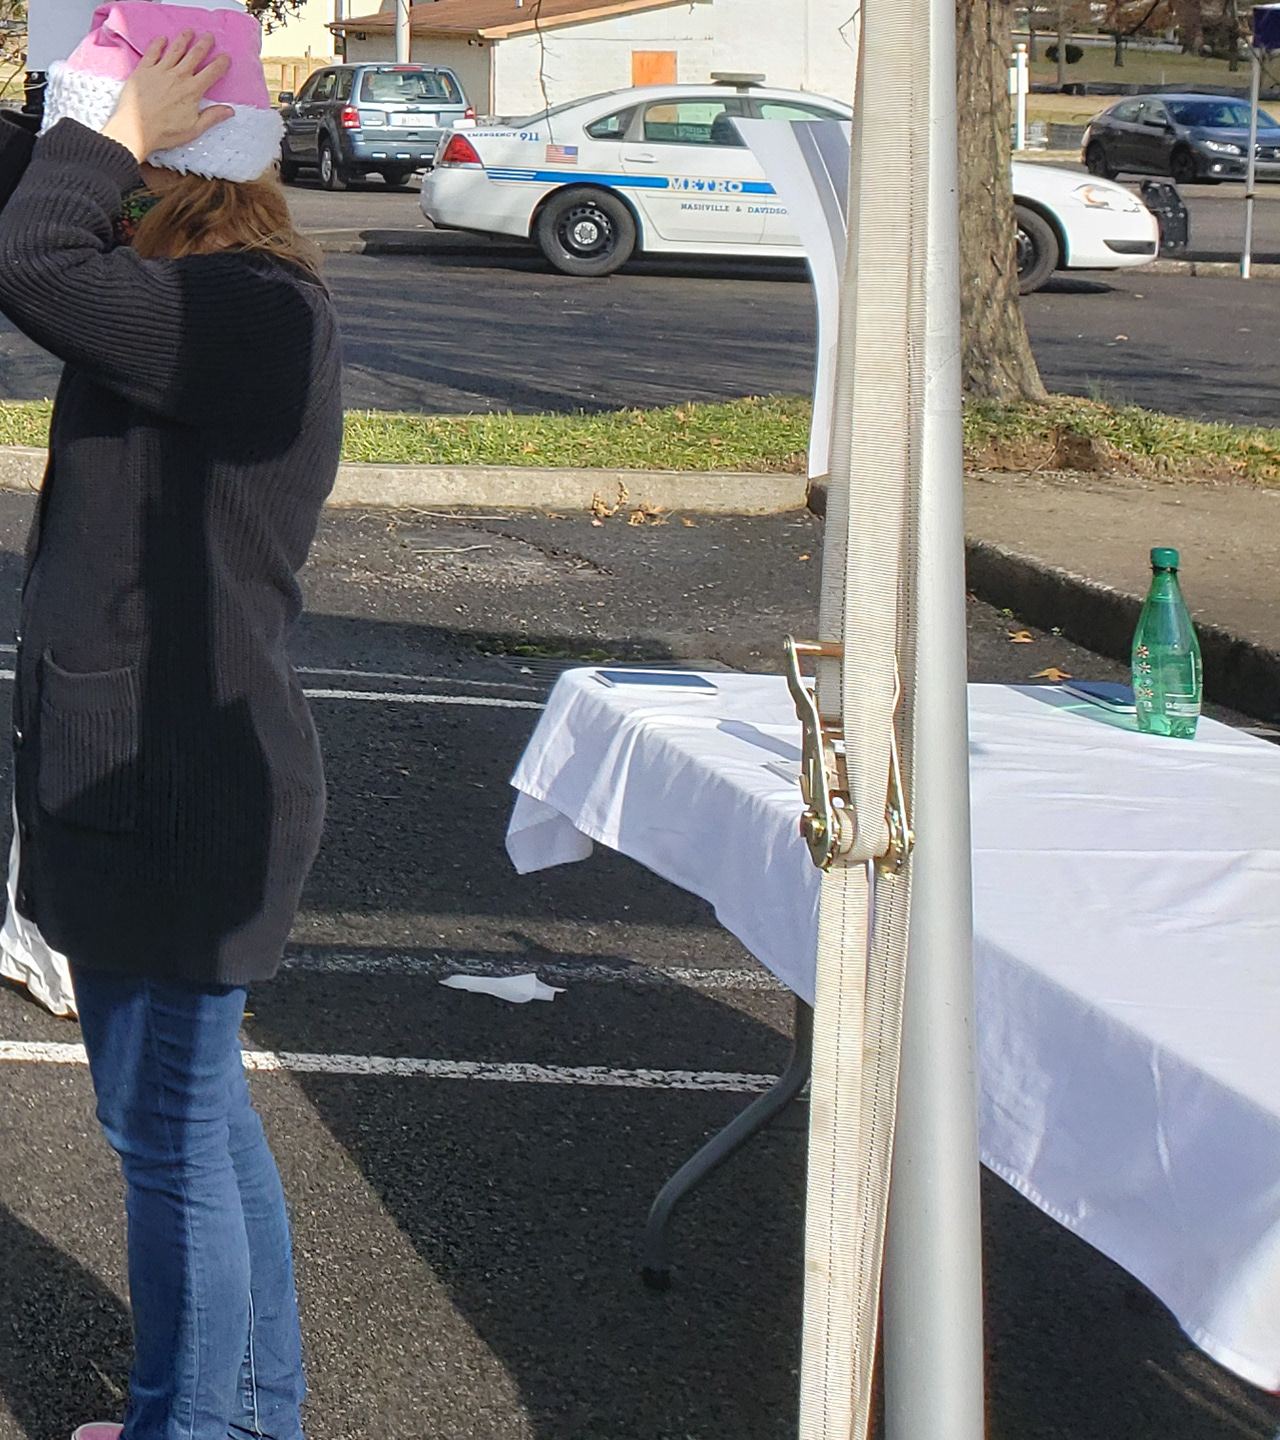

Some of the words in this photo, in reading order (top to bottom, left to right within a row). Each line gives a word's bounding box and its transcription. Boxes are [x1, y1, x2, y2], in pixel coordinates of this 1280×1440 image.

[520, 132, 540, 141] 911
[669, 177, 743, 193] METRO
[680, 202, 730, 212] NASHVILLE
[735, 204, 742, 213] &
[747, 206, 789, 215] DAVIDSO
